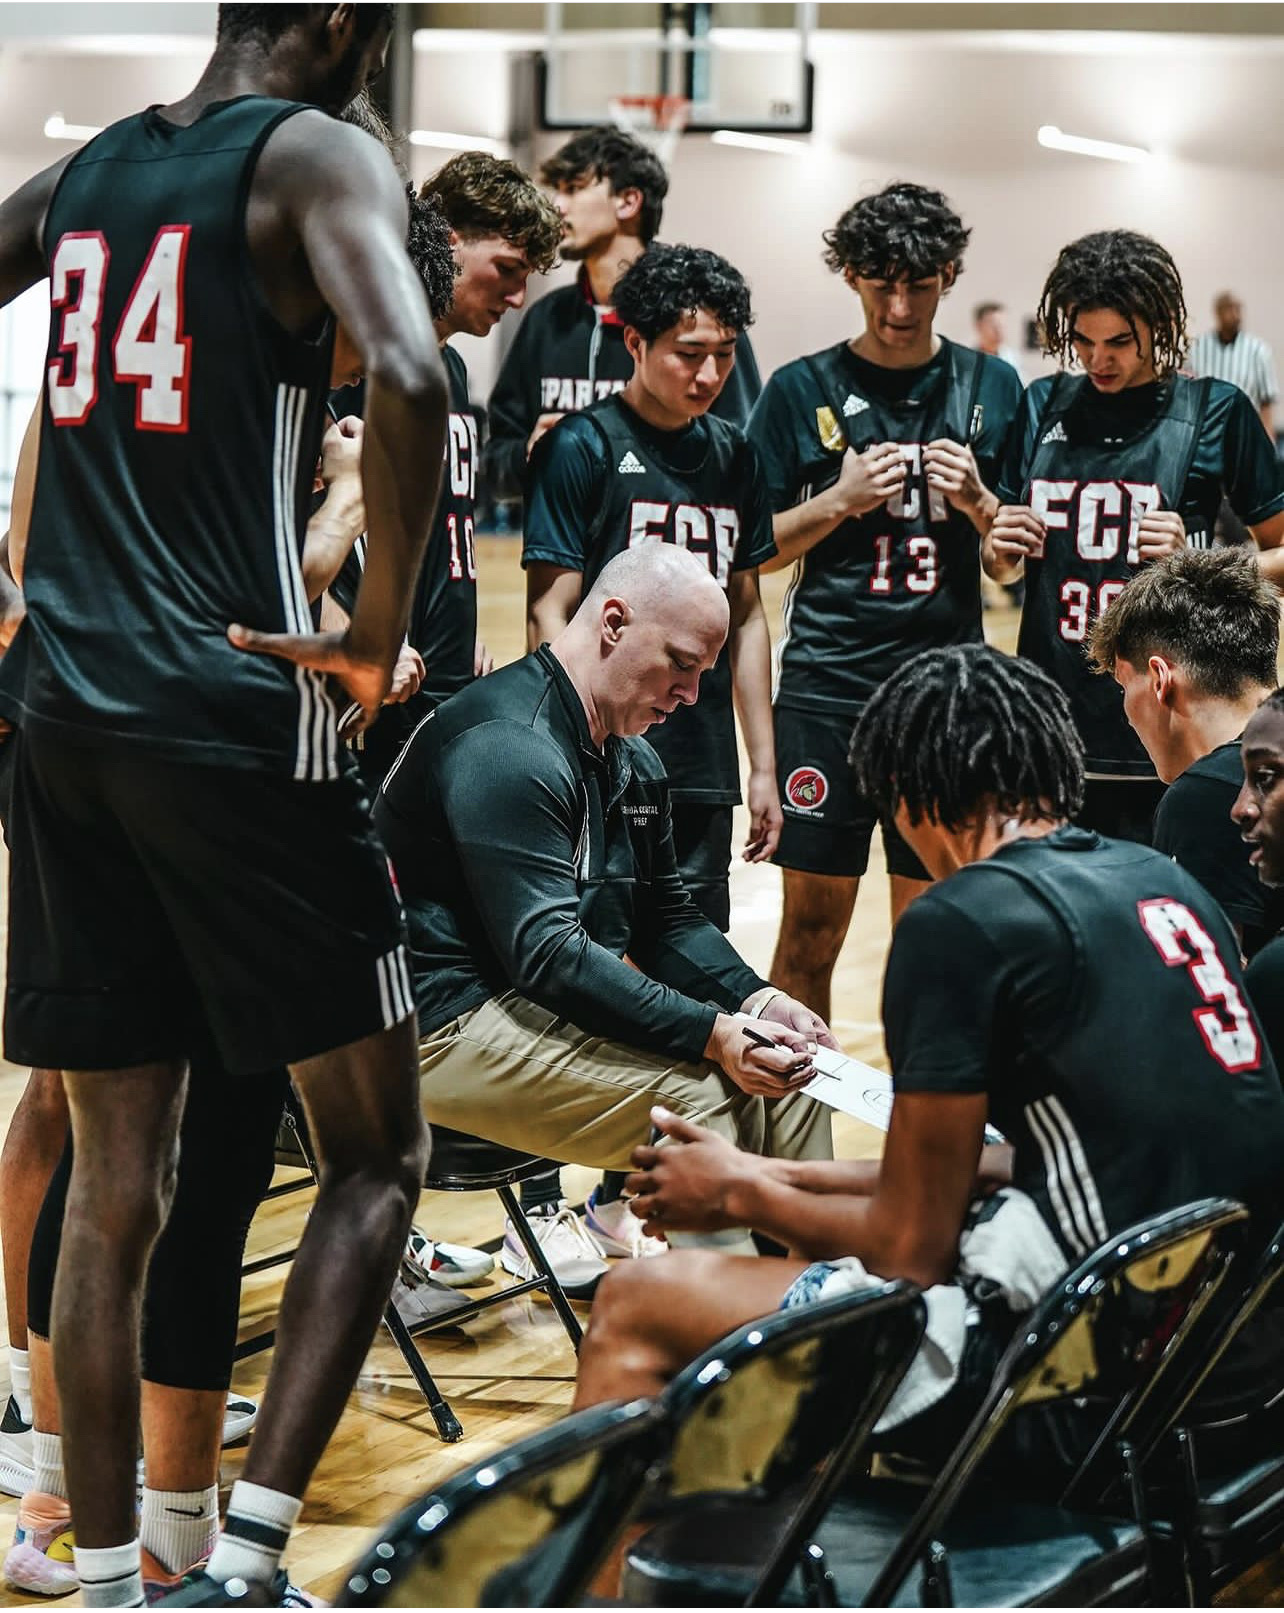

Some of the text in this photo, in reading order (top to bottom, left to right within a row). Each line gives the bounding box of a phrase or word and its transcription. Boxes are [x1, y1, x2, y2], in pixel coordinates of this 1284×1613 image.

[48, 224, 192, 433] 34
[541, 377, 625, 411] PART
[443, 412, 479, 500] CP
[870, 534, 938, 594] 13
[1136, 896, 1261, 1074] 3
